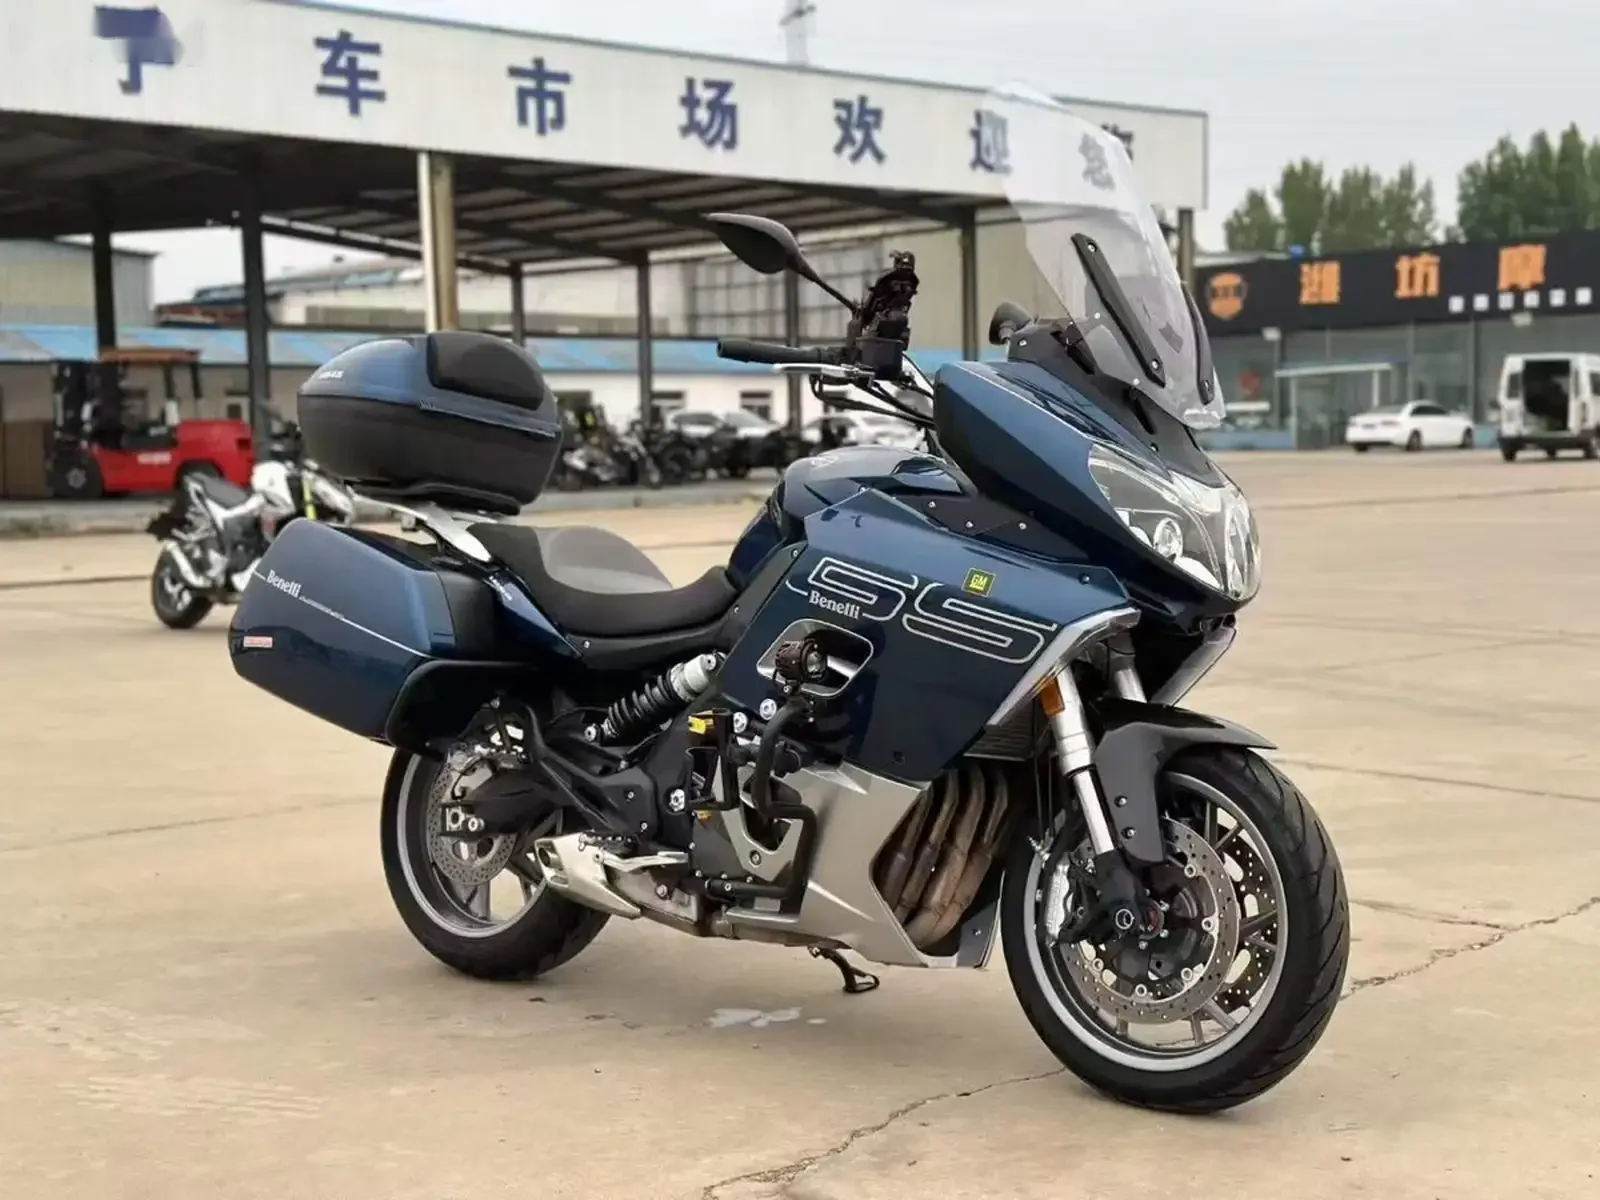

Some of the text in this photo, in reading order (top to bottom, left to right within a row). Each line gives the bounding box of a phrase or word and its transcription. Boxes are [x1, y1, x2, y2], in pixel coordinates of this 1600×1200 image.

[267, 569, 302, 598] Benelli
[968, 573, 989, 590] GM
[808, 589, 861, 620] Benelli
